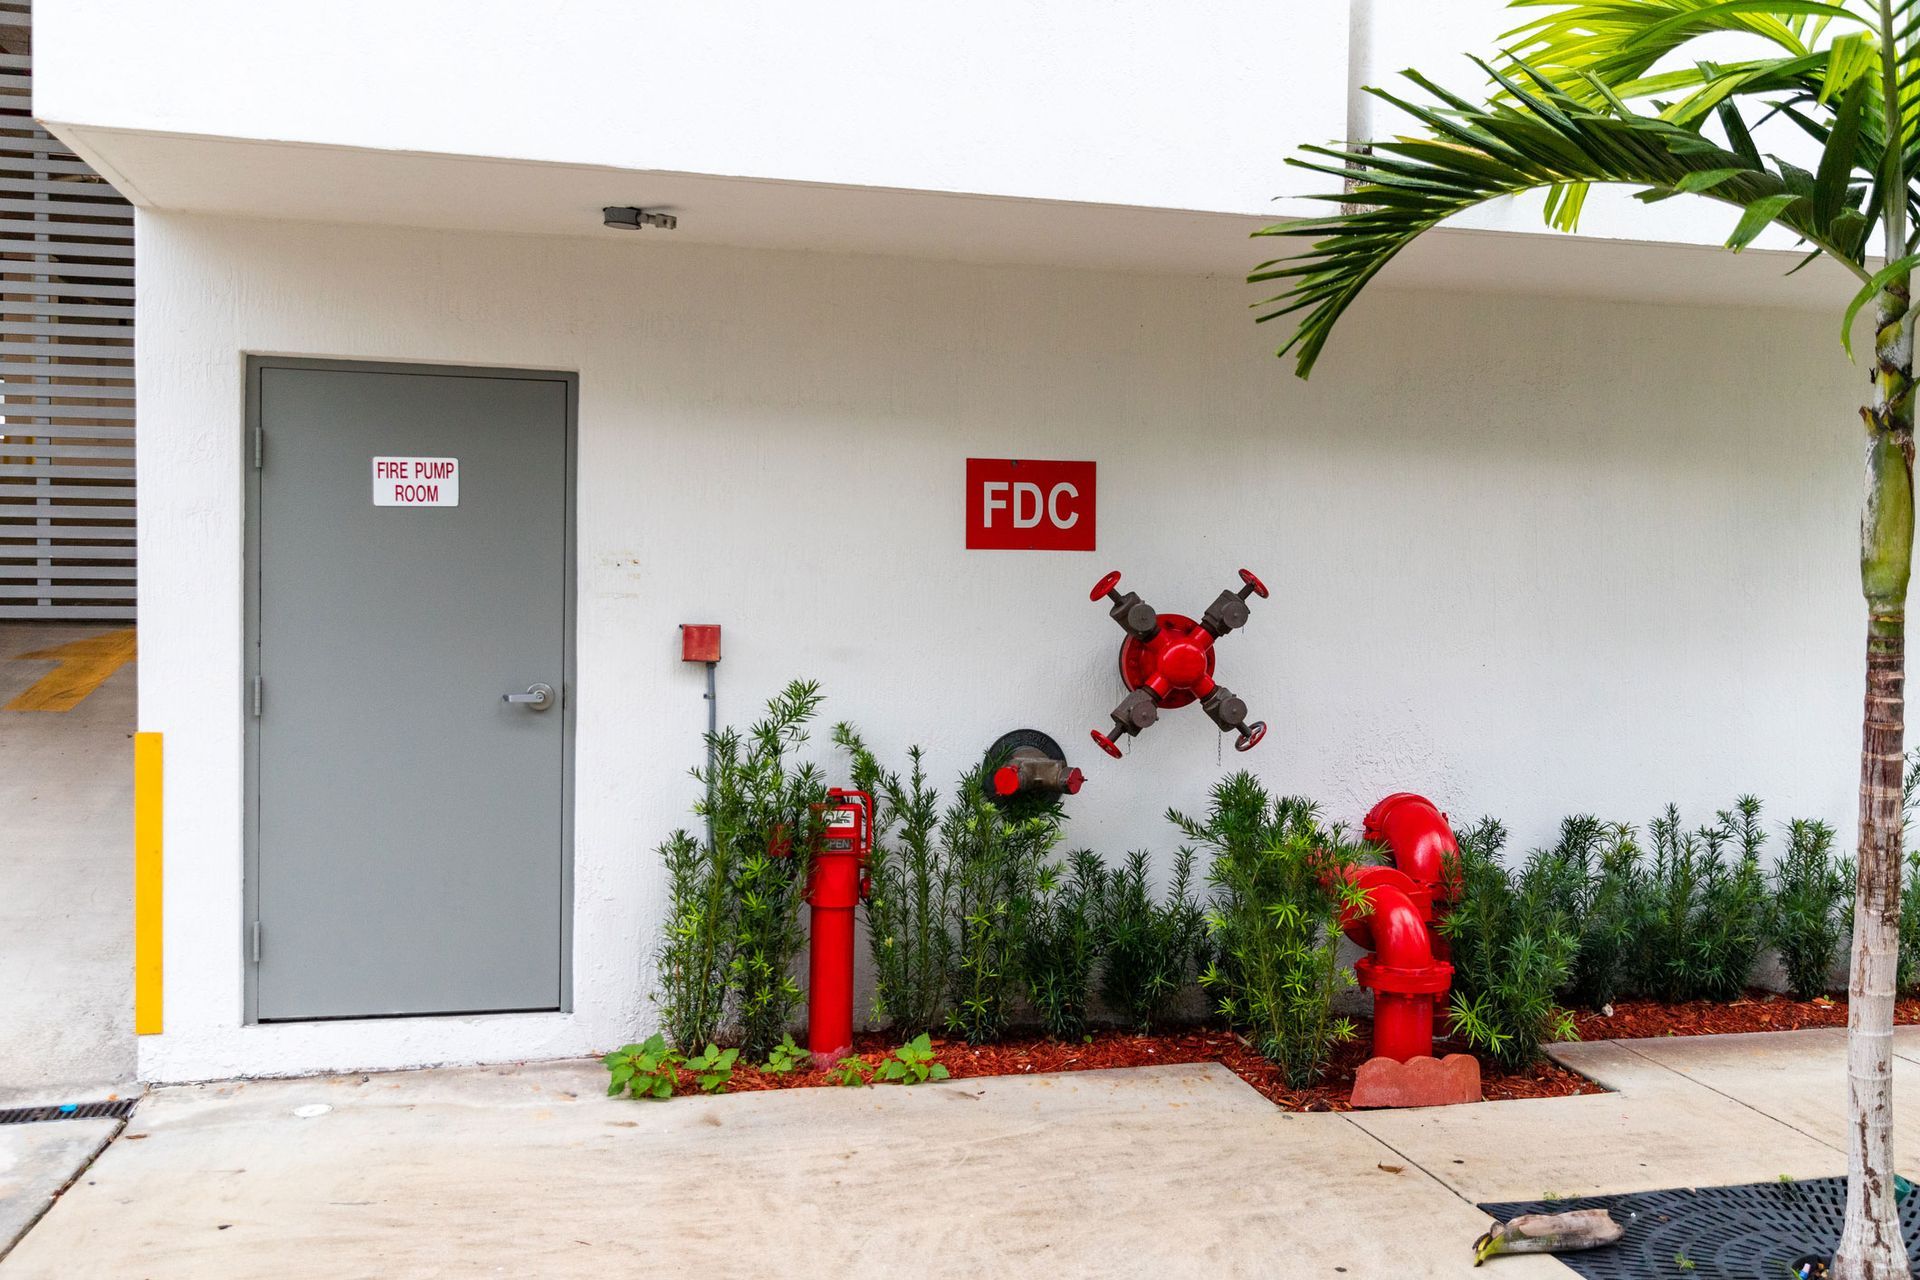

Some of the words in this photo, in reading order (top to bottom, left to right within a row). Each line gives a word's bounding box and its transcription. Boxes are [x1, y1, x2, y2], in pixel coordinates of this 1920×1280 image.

[377, 461, 408, 479] FIRE
[415, 461, 455, 479] PUMP
[395, 484, 439, 502] ROOM
[983, 481, 1079, 529] FDC
